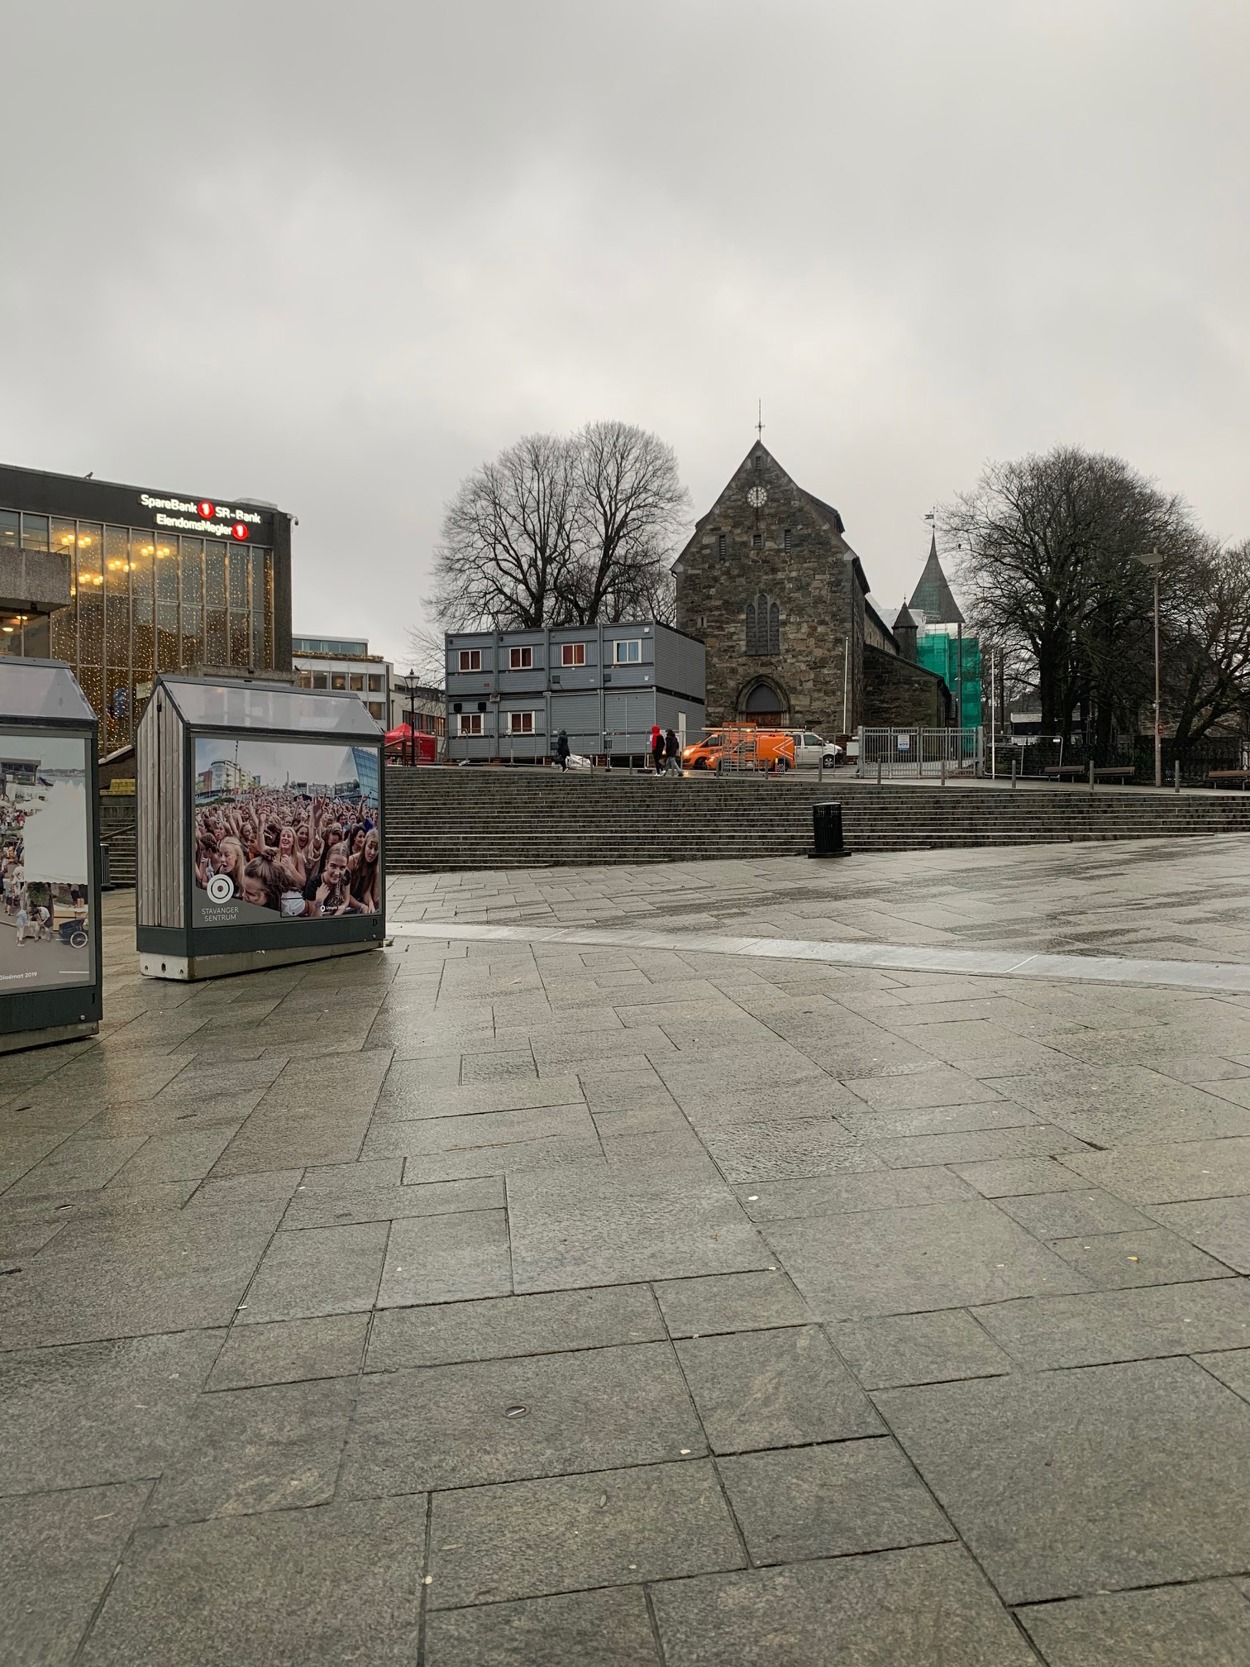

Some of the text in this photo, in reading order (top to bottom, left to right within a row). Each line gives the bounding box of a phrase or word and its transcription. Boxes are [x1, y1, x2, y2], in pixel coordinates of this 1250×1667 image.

[140, 494, 198, 514] SpareBank
[215, 506, 261, 524] SR-Bank
[156, 513, 232, 536] EiendomsMegler
[201, 906, 239, 915] STAVANGER
[204, 914, 237, 922] SENTRUM
